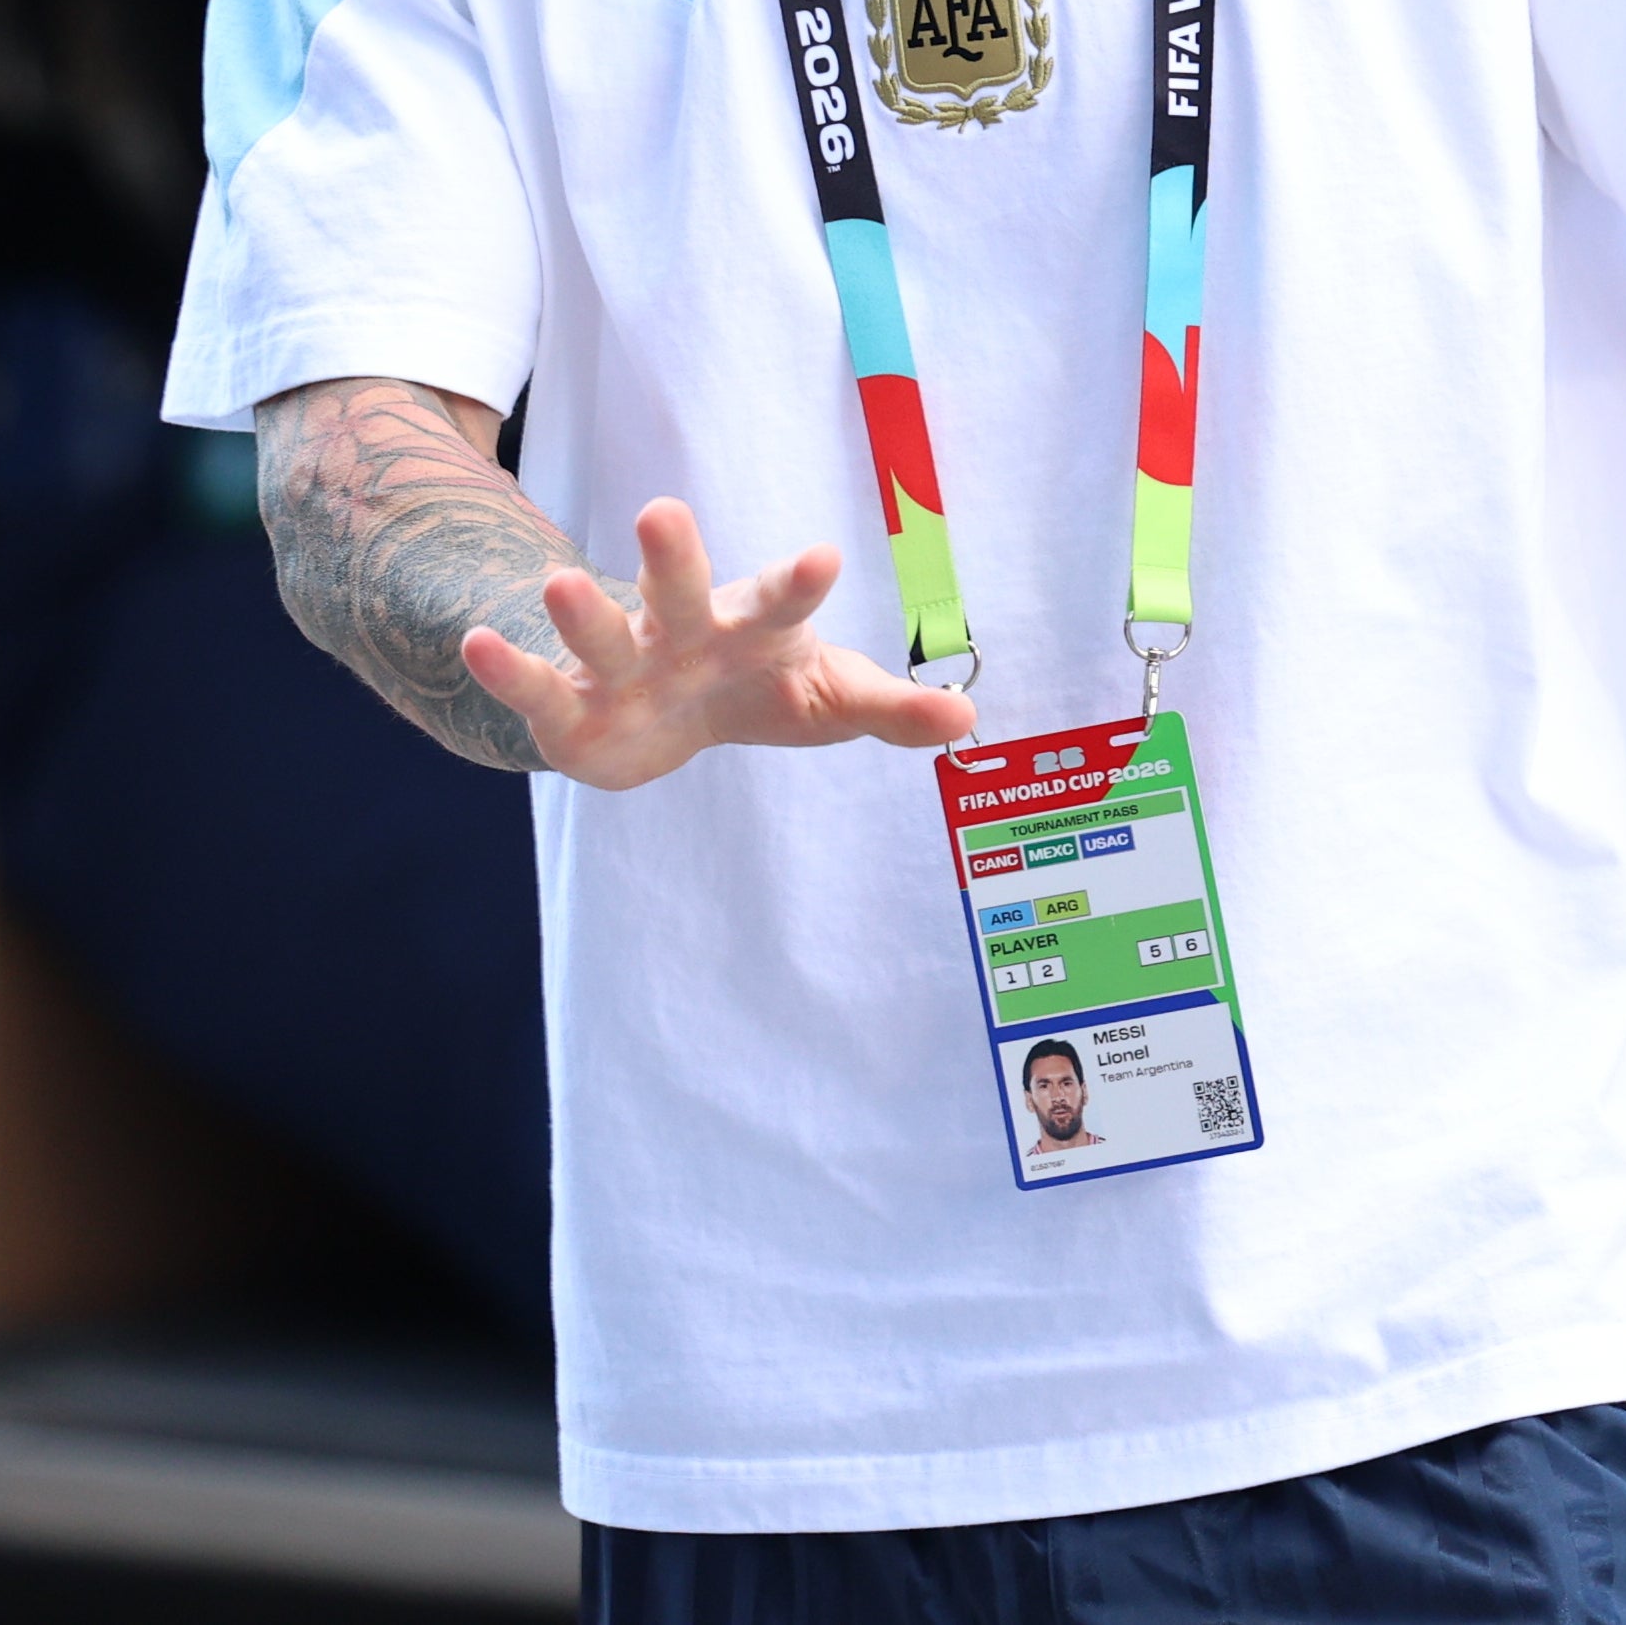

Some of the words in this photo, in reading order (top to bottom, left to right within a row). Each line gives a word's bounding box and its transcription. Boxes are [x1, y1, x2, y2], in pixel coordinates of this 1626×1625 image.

[1167, 21, 1201, 118] FIFA
[1032, 746, 1086, 775] 26
[958, 792, 999, 812] FIFA
[999, 779, 1067, 804] WORLD
[1069, 770, 1105, 791] CUP
[1107, 758, 1171, 784] 2026
[1010, 811, 1100, 837] TOURNAMENT
[1103, 804, 1139, 820] PASS
[1028, 842, 1075, 863] MEXC
[1085, 832, 1130, 852] USAC
[972, 853, 1019, 873] CANC
[990, 909, 1024, 926] ARG
[1046, 899, 1079, 916] ARG
[990, 933, 1059, 957] PLAYER
[1150, 944, 1162, 958] 5
[1185, 938, 1198, 952] 6
[1007, 971, 1017, 984] 1
[1042, 964, 1054, 978] 2
[1093, 1024, 1146, 1045] MESSI
[1097, 1045, 1150, 1067] Lionel
[1100, 1070, 1133, 1084] Team
[1136, 1059, 1194, 1077] Argentina
